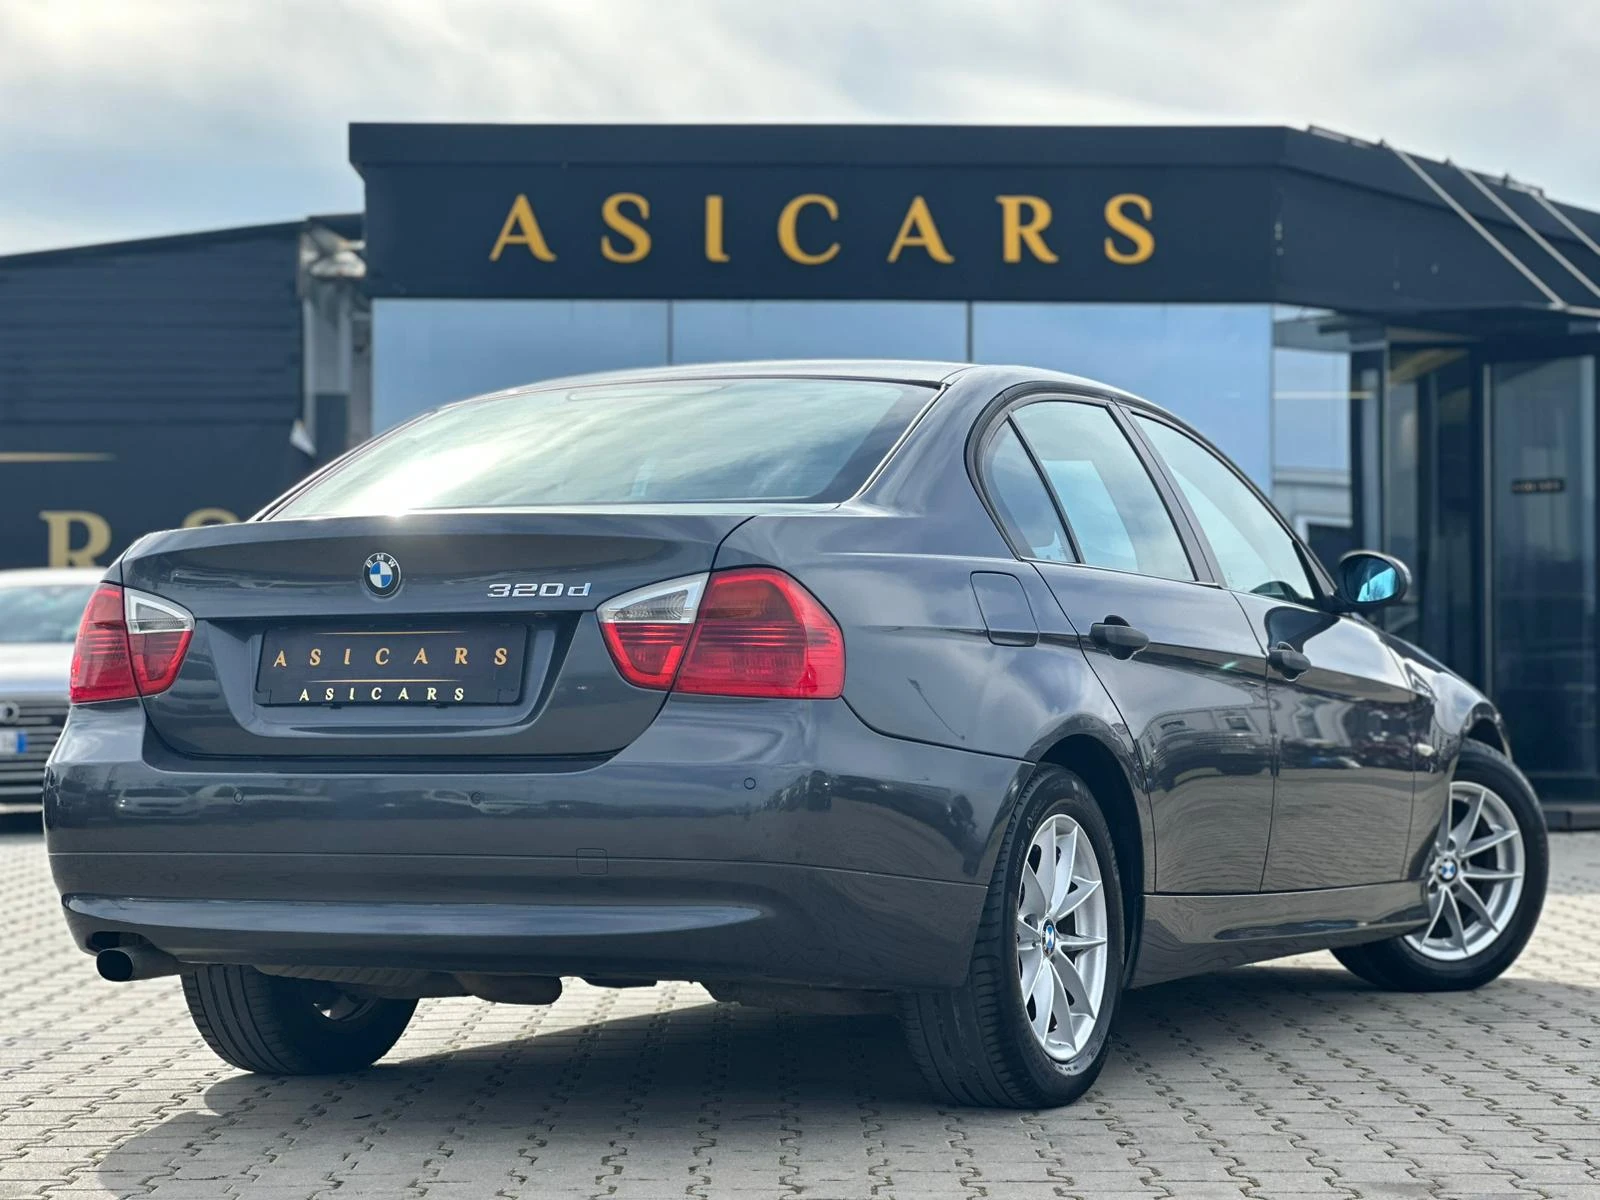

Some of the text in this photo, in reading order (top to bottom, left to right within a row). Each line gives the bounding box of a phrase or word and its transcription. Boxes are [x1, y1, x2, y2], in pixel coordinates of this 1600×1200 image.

[489, 192, 1156, 264] ASICARS
[366, 554, 396, 568] BMW
[487, 583, 591, 598] 320d
[273, 647, 508, 668] ASICARS
[299, 687, 464, 702] ASICARS
